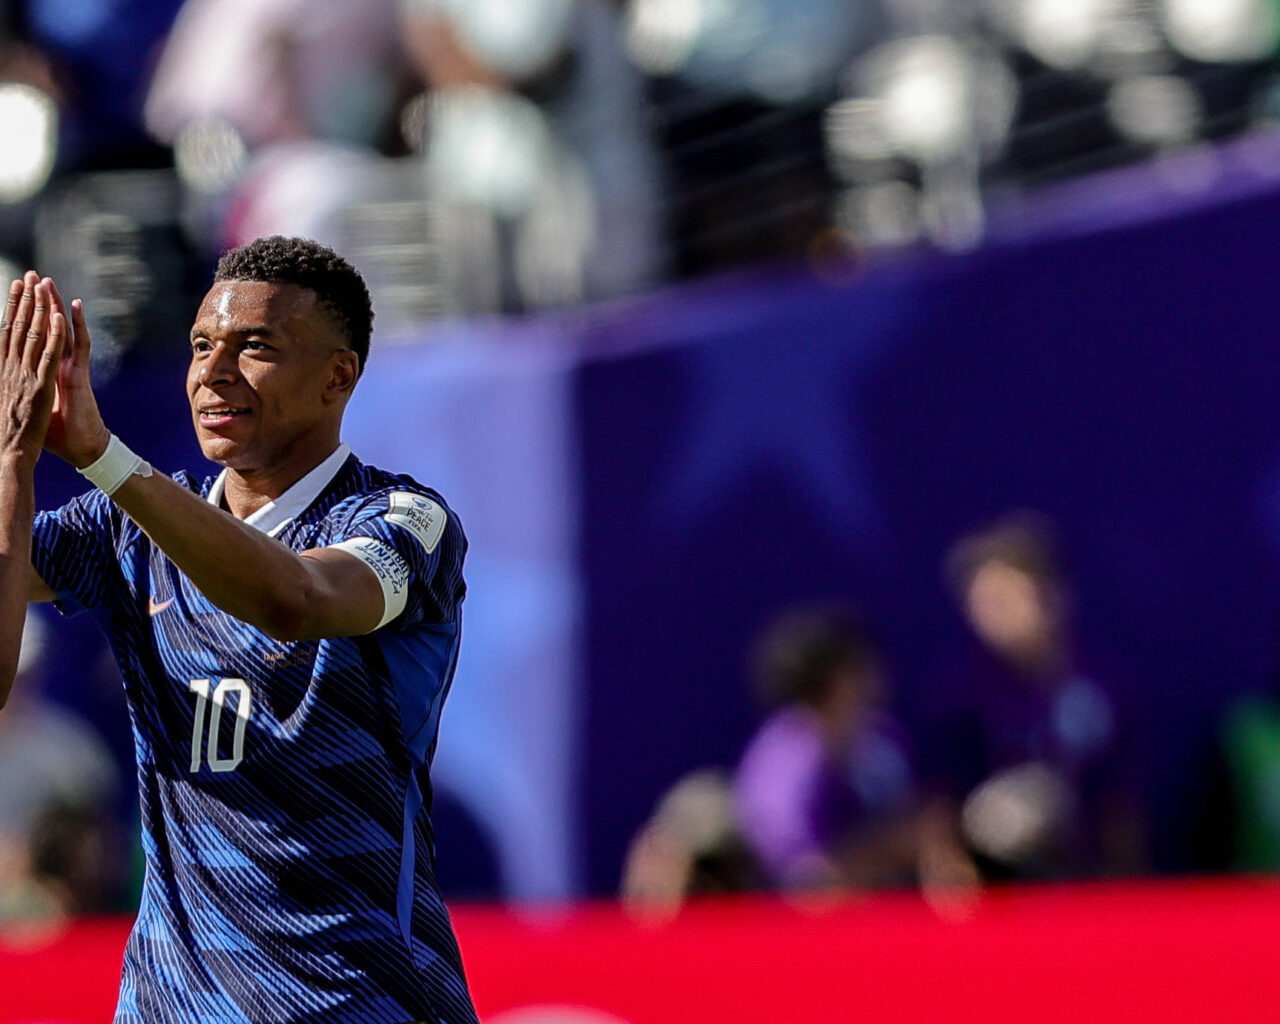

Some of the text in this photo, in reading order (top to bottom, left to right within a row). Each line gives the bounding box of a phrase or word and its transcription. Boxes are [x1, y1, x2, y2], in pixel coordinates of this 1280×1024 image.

[407, 508, 431, 532] PEACE
[364, 541, 406, 588] UNITES
[189, 678, 252, 773] 10
